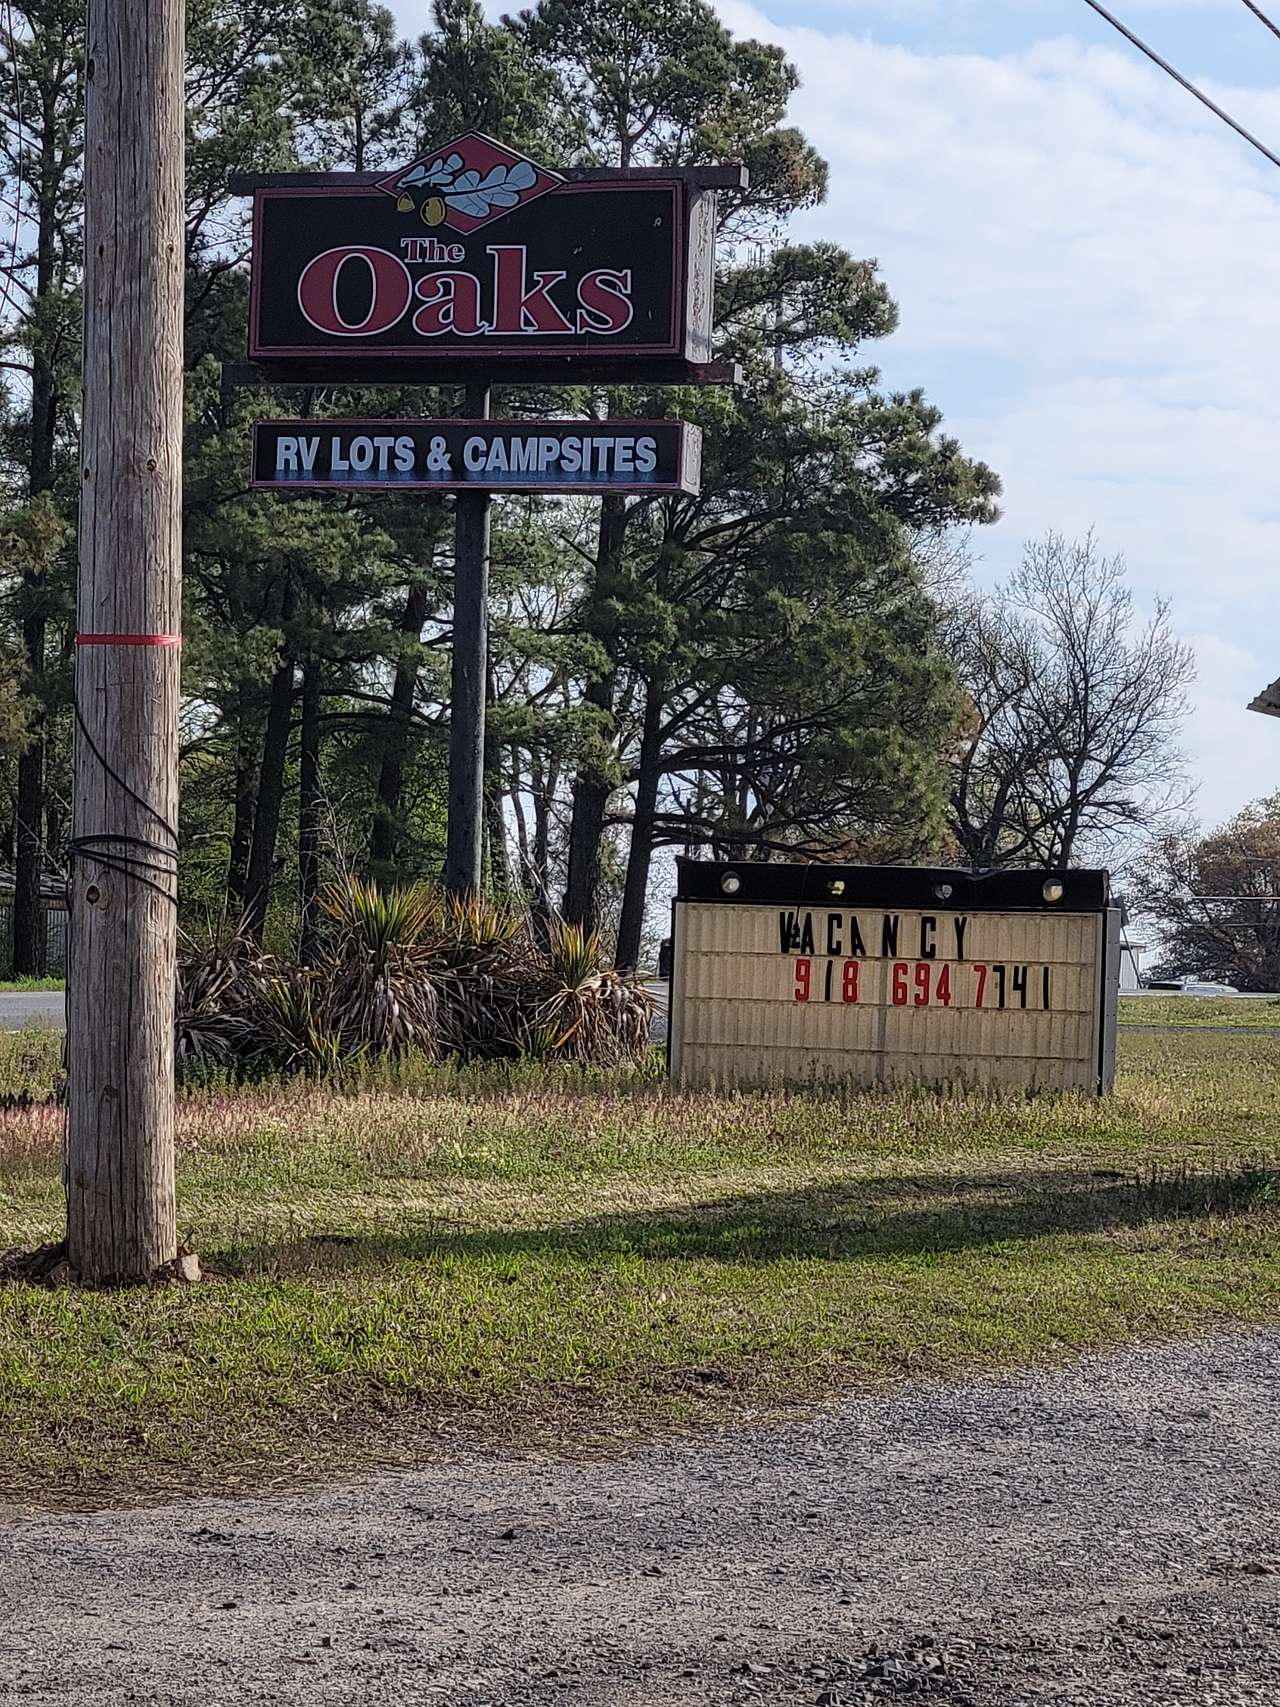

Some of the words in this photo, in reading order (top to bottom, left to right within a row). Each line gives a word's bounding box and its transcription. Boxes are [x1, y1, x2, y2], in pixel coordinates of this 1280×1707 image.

[400, 237, 465, 263] The
[297, 245, 634, 337] Oaks
[275, 435, 320, 472] RV
[330, 436, 416, 472] LOTS
[426, 436, 452, 472] &
[463, 436, 658, 473] CAMPSITES
[779, 911, 967, 960] VACANCY
[794, 958, 861, 1003] 918
[892, 962, 952, 1007] 694
[974, 964, 1049, 1010] 7741
